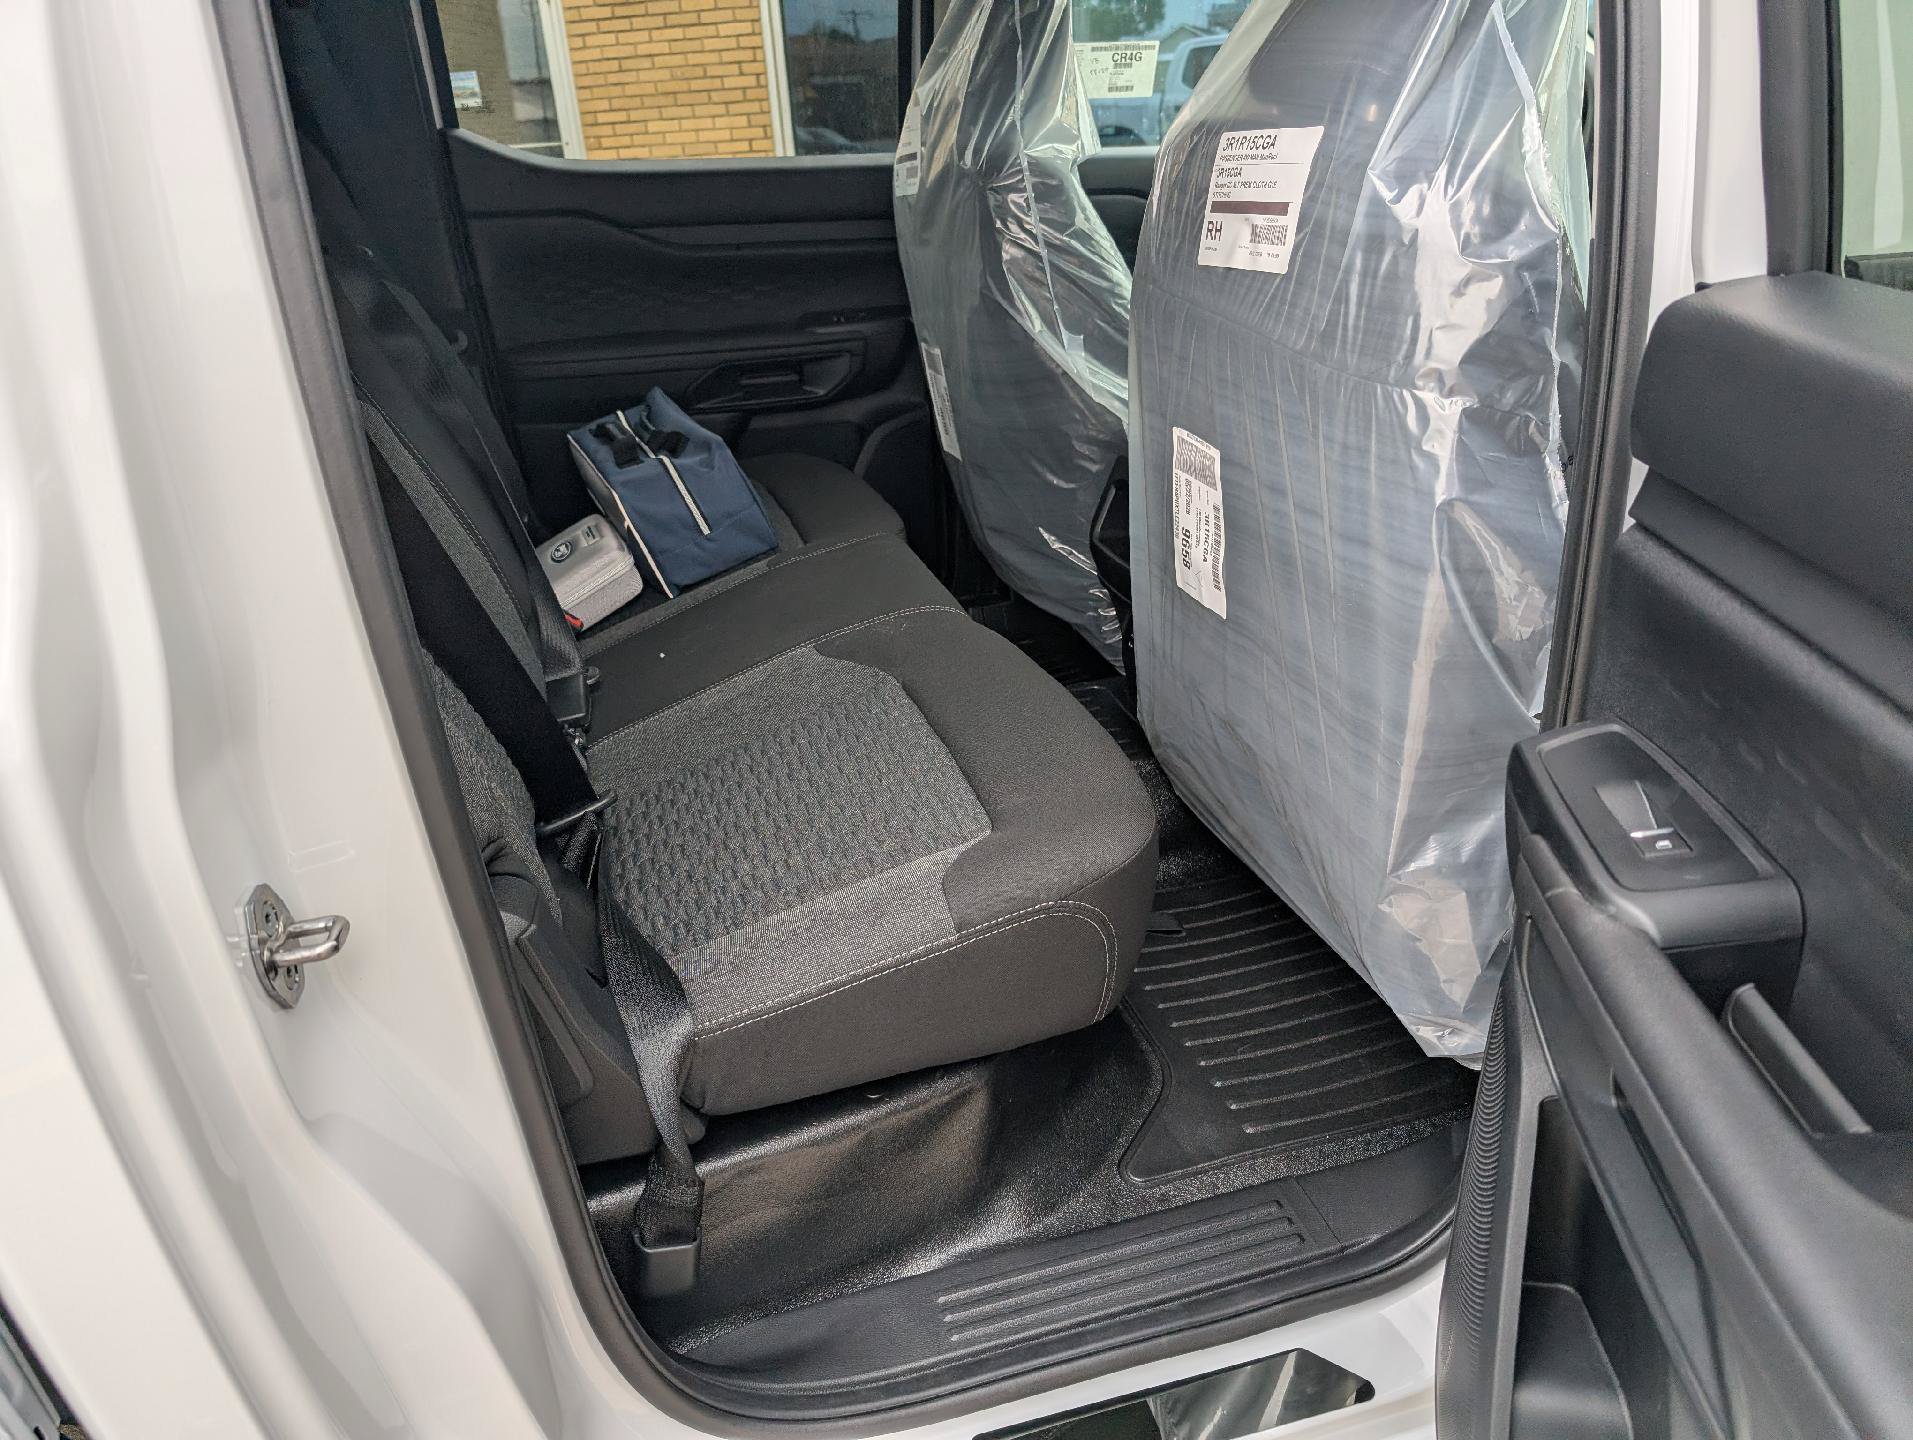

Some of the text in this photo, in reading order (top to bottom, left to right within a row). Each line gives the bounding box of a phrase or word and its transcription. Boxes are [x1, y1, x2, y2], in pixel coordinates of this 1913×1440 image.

[1112, 52, 1143, 62] CR4G
[1223, 135, 1278, 151] 3R1R15CGA
[1205, 220, 1223, 241] RH
[1181, 526, 1191, 570] 9658
